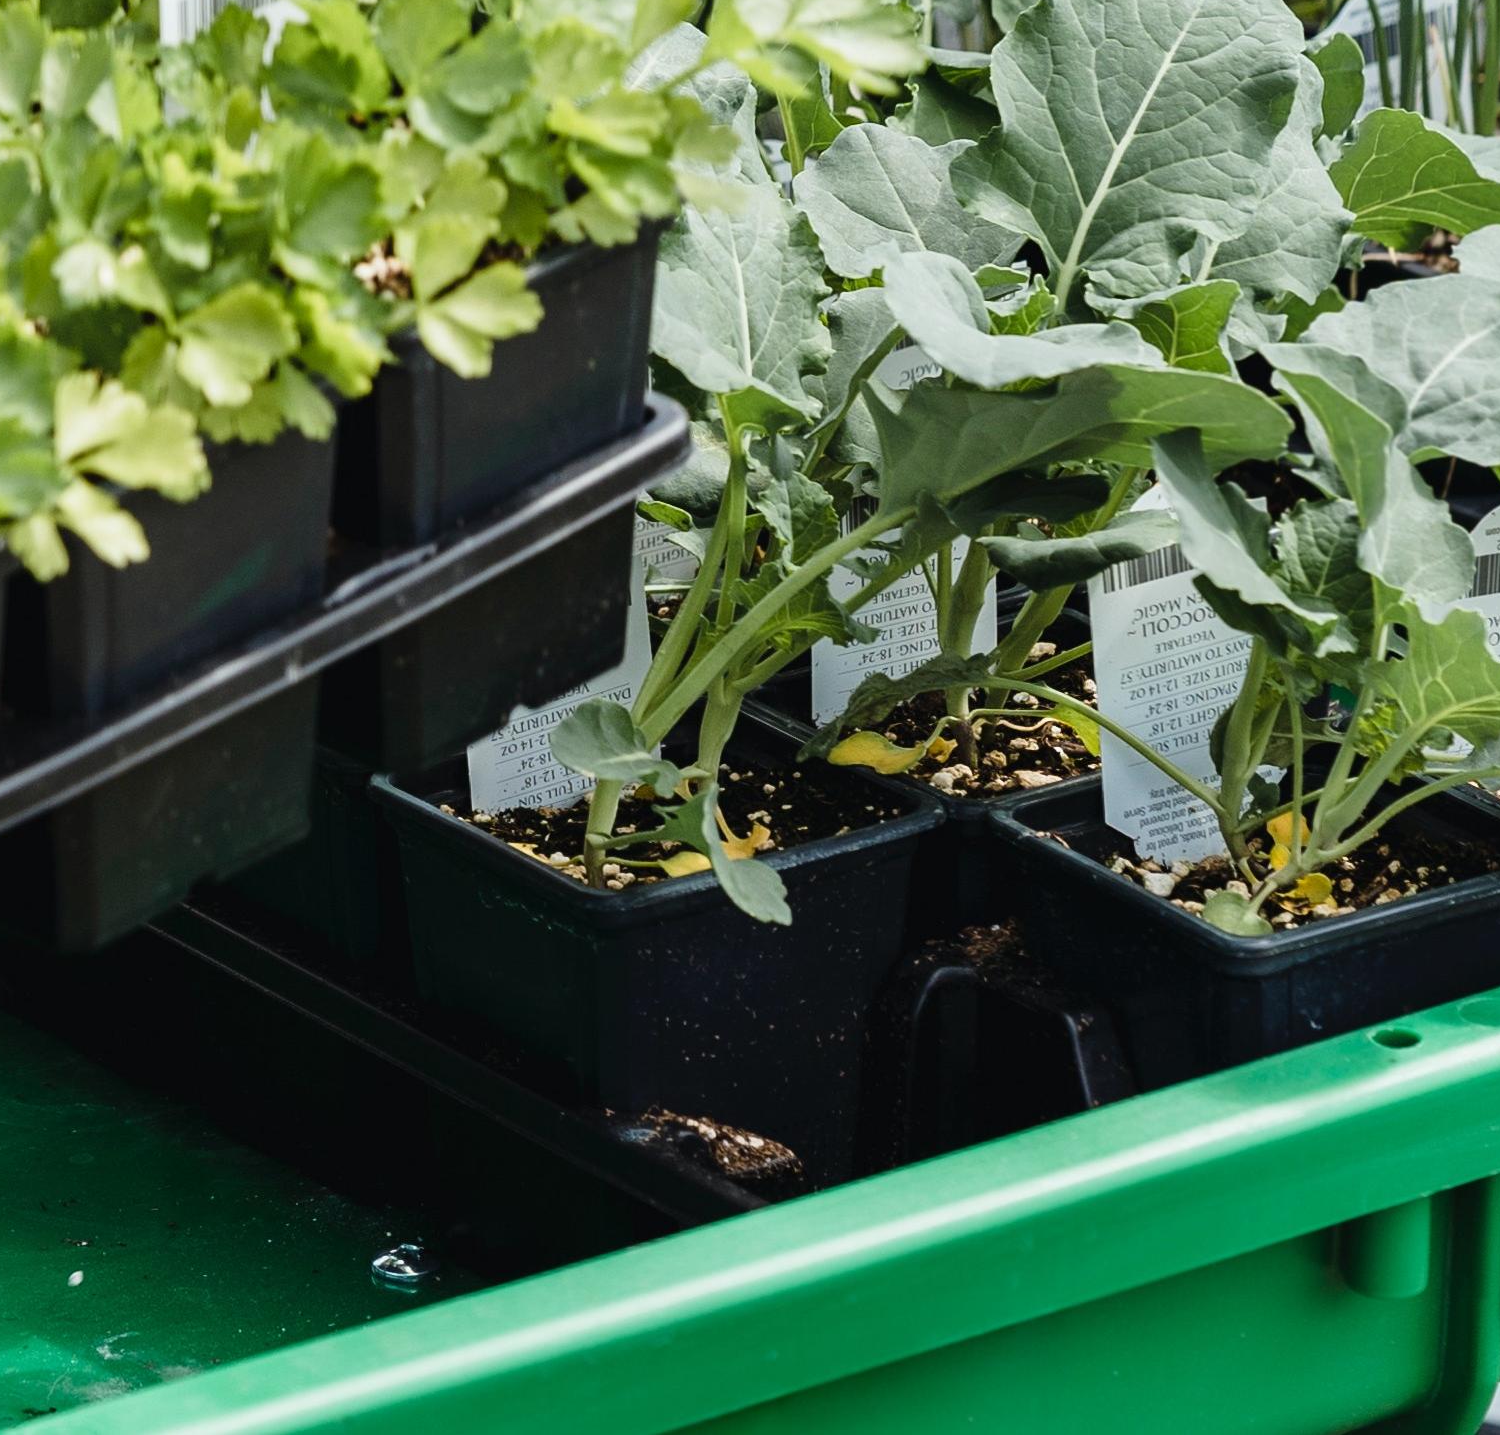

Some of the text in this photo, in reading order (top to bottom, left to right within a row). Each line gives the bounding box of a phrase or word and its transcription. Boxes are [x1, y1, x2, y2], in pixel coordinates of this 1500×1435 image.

[897, 622, 926, 635] SIZE:
[1142, 606, 1215, 637] ROCCOLI
[895, 637, 939, 655] ACING:
[1155, 630, 1216, 654] VEGETABLE
[1205, 646, 1222, 660] TO
[1136, 653, 1201, 678] MATURITY:
[1120, 672, 1133, 685] 57
[1129, 658, 1248, 701] FRUIT SIZE: 12-14 OZ
[1182, 682, 1238, 705] SPACING:
[508, 705, 576, 736] MATURITY:
[501, 743, 518, 756] OZ
[1174, 732, 1198, 750] FULL
[545, 781, 573, 799] FULL
[519, 794, 542, 806] SUN
[1123, 807, 1146, 819] Serve
[1140, 812, 1170, 829] covered
[1171, 809, 1186, 821] and
[1148, 822, 1183, 837] Delicious
